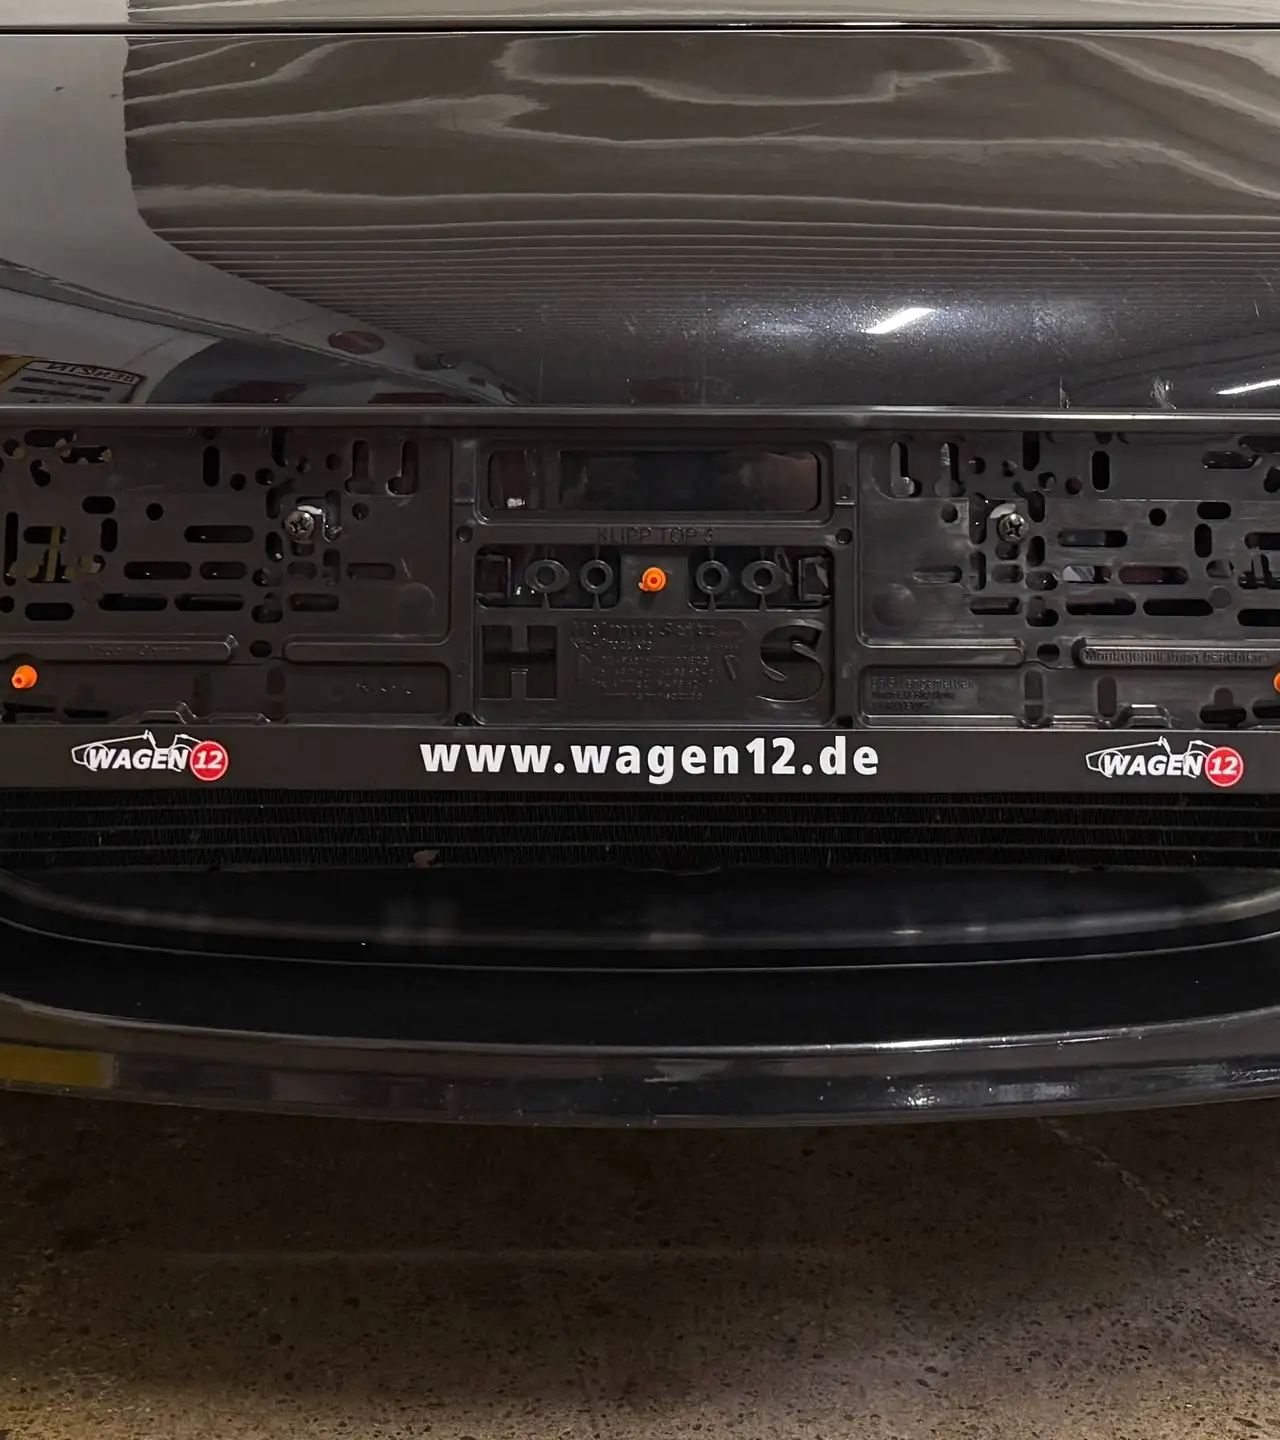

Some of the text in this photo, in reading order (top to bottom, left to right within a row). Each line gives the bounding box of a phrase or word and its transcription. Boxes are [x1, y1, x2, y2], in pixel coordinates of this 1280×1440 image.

[659, 526, 698, 544] TOP
[89, 748, 223, 770] WAGEN 12
[420, 736, 879, 784] www.wagen12.de
[1104, 754, 1238, 776] WAGEN 12
